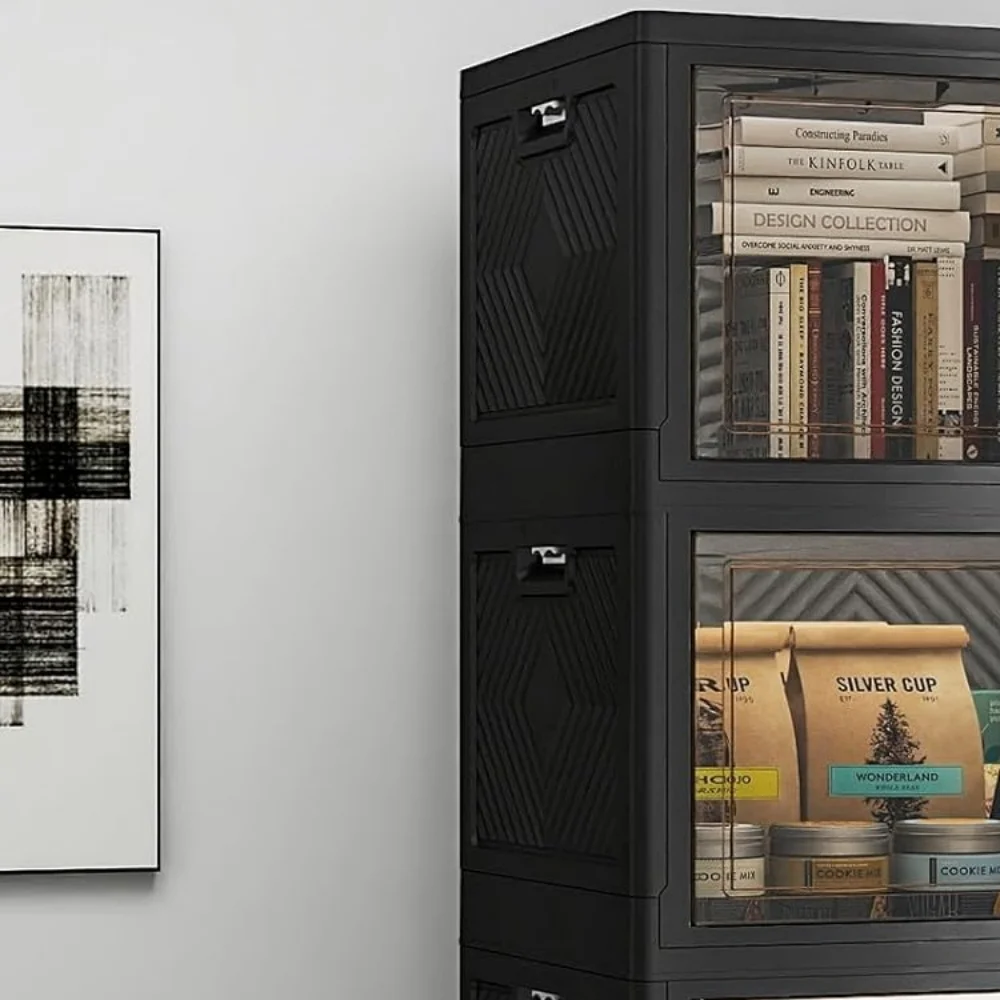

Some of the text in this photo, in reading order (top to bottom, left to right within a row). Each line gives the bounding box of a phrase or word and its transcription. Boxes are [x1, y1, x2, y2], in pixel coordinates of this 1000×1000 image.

[796, 128, 851, 143] Constructing
[809, 156, 877, 171] KINFOLK
[879, 161, 905, 170] TABLE
[809, 188, 855, 198] ENGINEERING
[753, 212, 928, 233] DESIGN COLLECTION
[742, 241, 776, 250] OVERCOME
[860, 294, 869, 365] Conversations
[891, 311, 904, 426] FASHION DESIGN
[860, 368, 869, 389] with
[966, 346, 974, 411] LANDSCAPES
[835, 676, 938, 693] SILVER CUP
[855, 772, 940, 783] WONDERLAND
[739, 870, 757, 880] MIX
[817, 868, 865, 879] COOKIE
[940, 866, 987, 876] COOKIE
